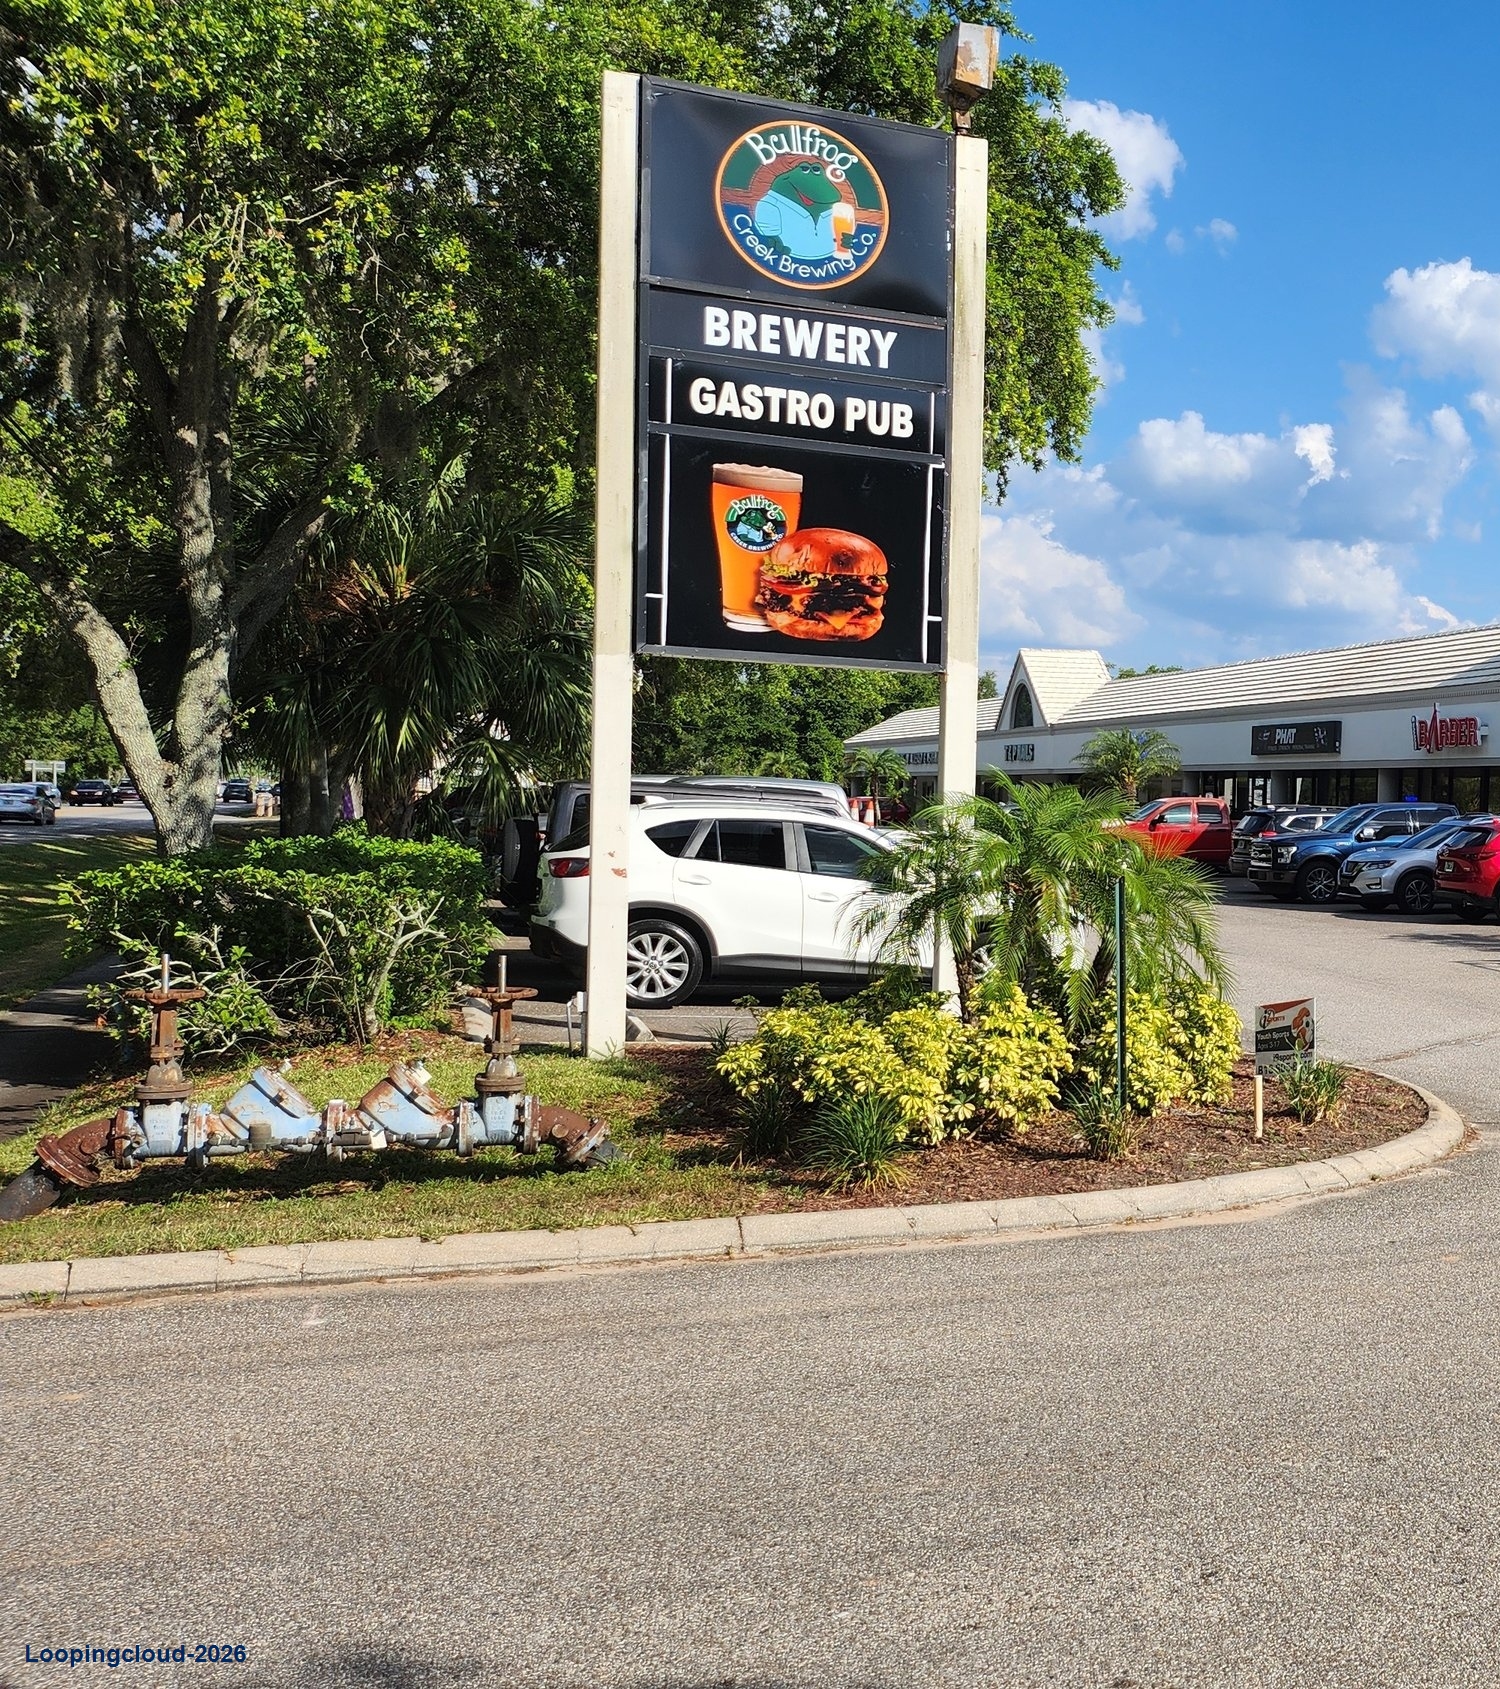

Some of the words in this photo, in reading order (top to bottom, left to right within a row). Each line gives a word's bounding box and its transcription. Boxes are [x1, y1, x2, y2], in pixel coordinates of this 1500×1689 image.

[745, 125, 858, 182] Bullfrog
[734, 214, 778, 266] Creek
[779, 257, 857, 278] Brewing
[851, 233, 877, 256] Co.
[704, 306, 898, 369] BREWERY
[690, 377, 835, 429] GASTRO
[844, 396, 914, 438] PUB
[730, 494, 782, 520] Bullfrog
[1274, 728, 1297, 744] PHAT
[1418, 703, 1479, 754] BARBER
[1272, 1031, 1290, 1039] Sports
